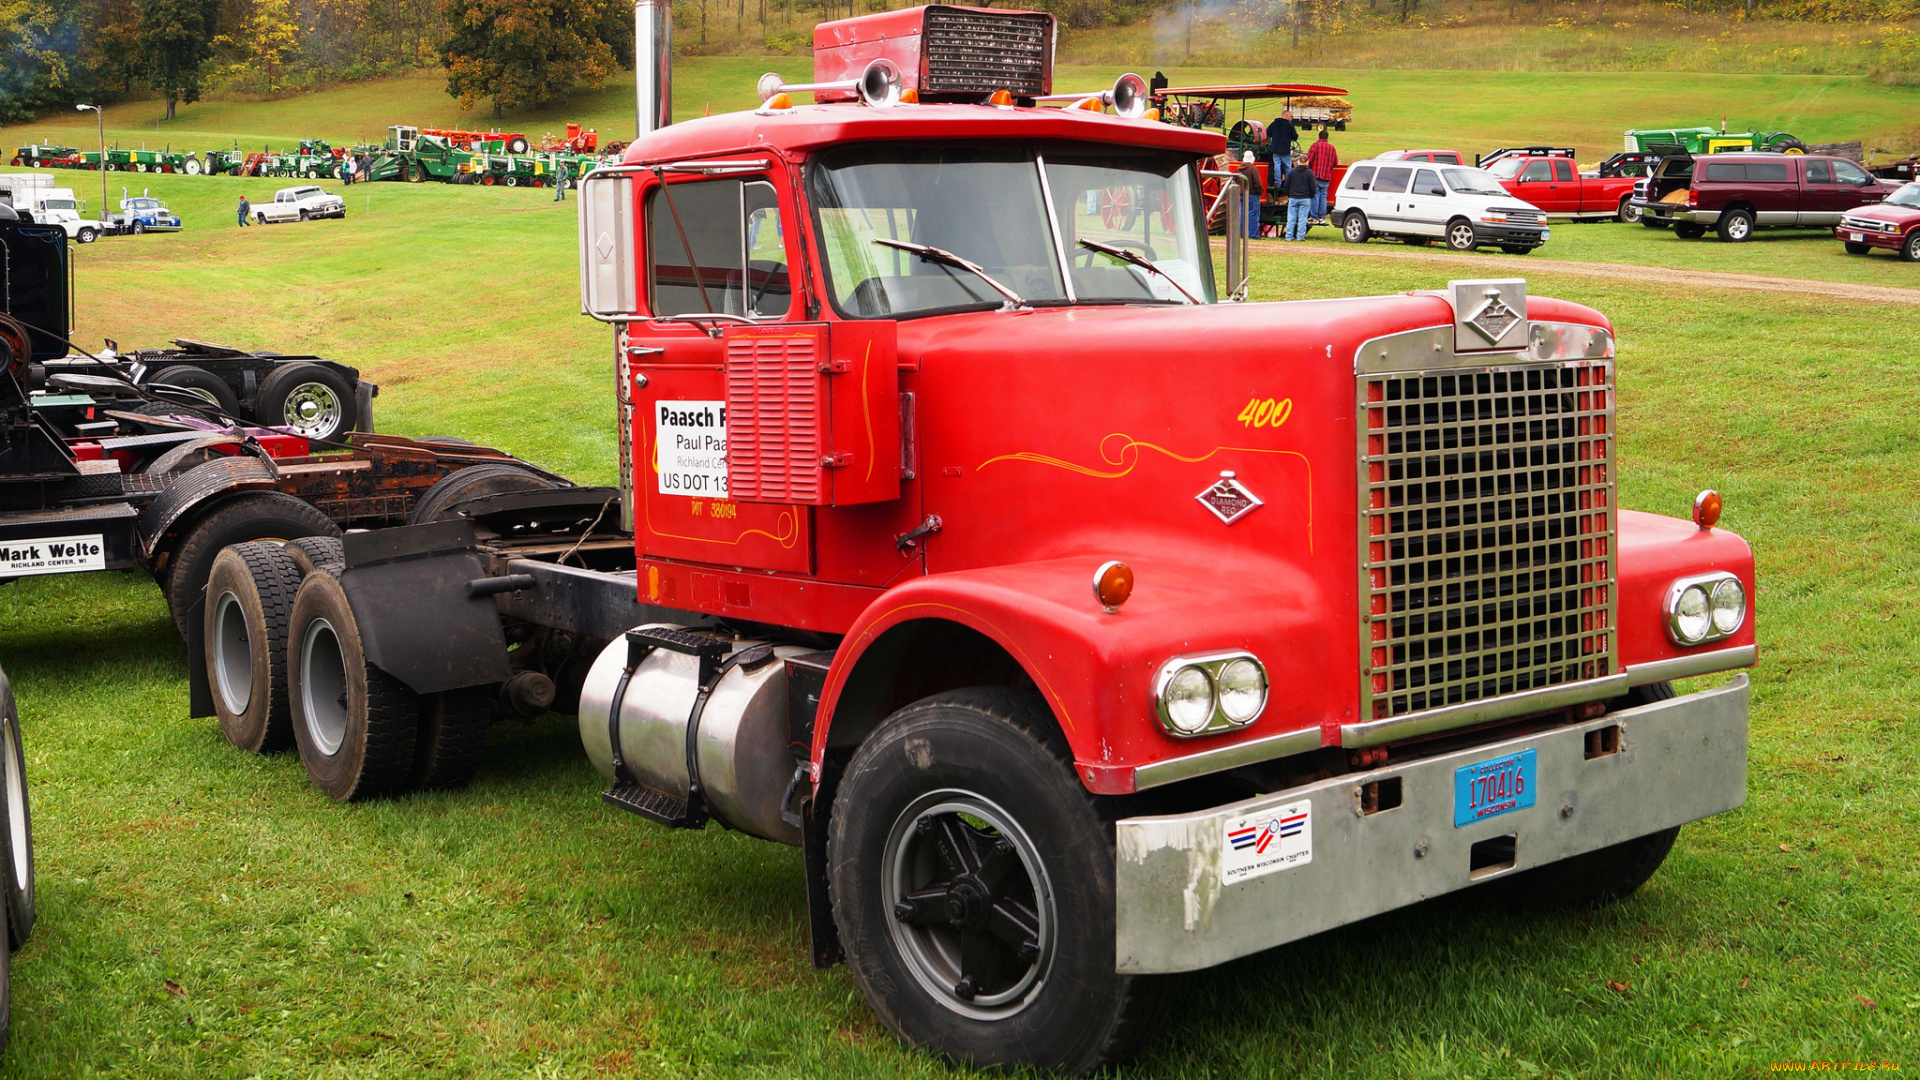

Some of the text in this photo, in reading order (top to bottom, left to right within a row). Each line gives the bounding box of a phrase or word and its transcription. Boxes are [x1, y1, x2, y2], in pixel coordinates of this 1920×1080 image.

[661, 406, 714, 428] Paasch
[1237, 398, 1293, 428] 400
[676, 434, 728, 452] Paul Paa
[676, 455, 710, 469] Richland
[663, 472, 729, 493] US DOT 13
[1210, 496, 1248, 508] DIAMOND
[1220, 505, 1237, 515] REO
[0, 542, 100, 562] Mark Welte
[11, 560, 45, 569] RICHLAND
[47, 558, 76, 567] CENTER,
[1480, 758, 1515, 774] COLLECTOR
[1469, 765, 1525, 809] 170416
[1476, 798, 1517, 818] WISCONSIN
[1227, 865, 1255, 876] SOUTHERN
[1256, 857, 1284, 868] WISCONSIN
[1286, 850, 1310, 861] CHAPTER
